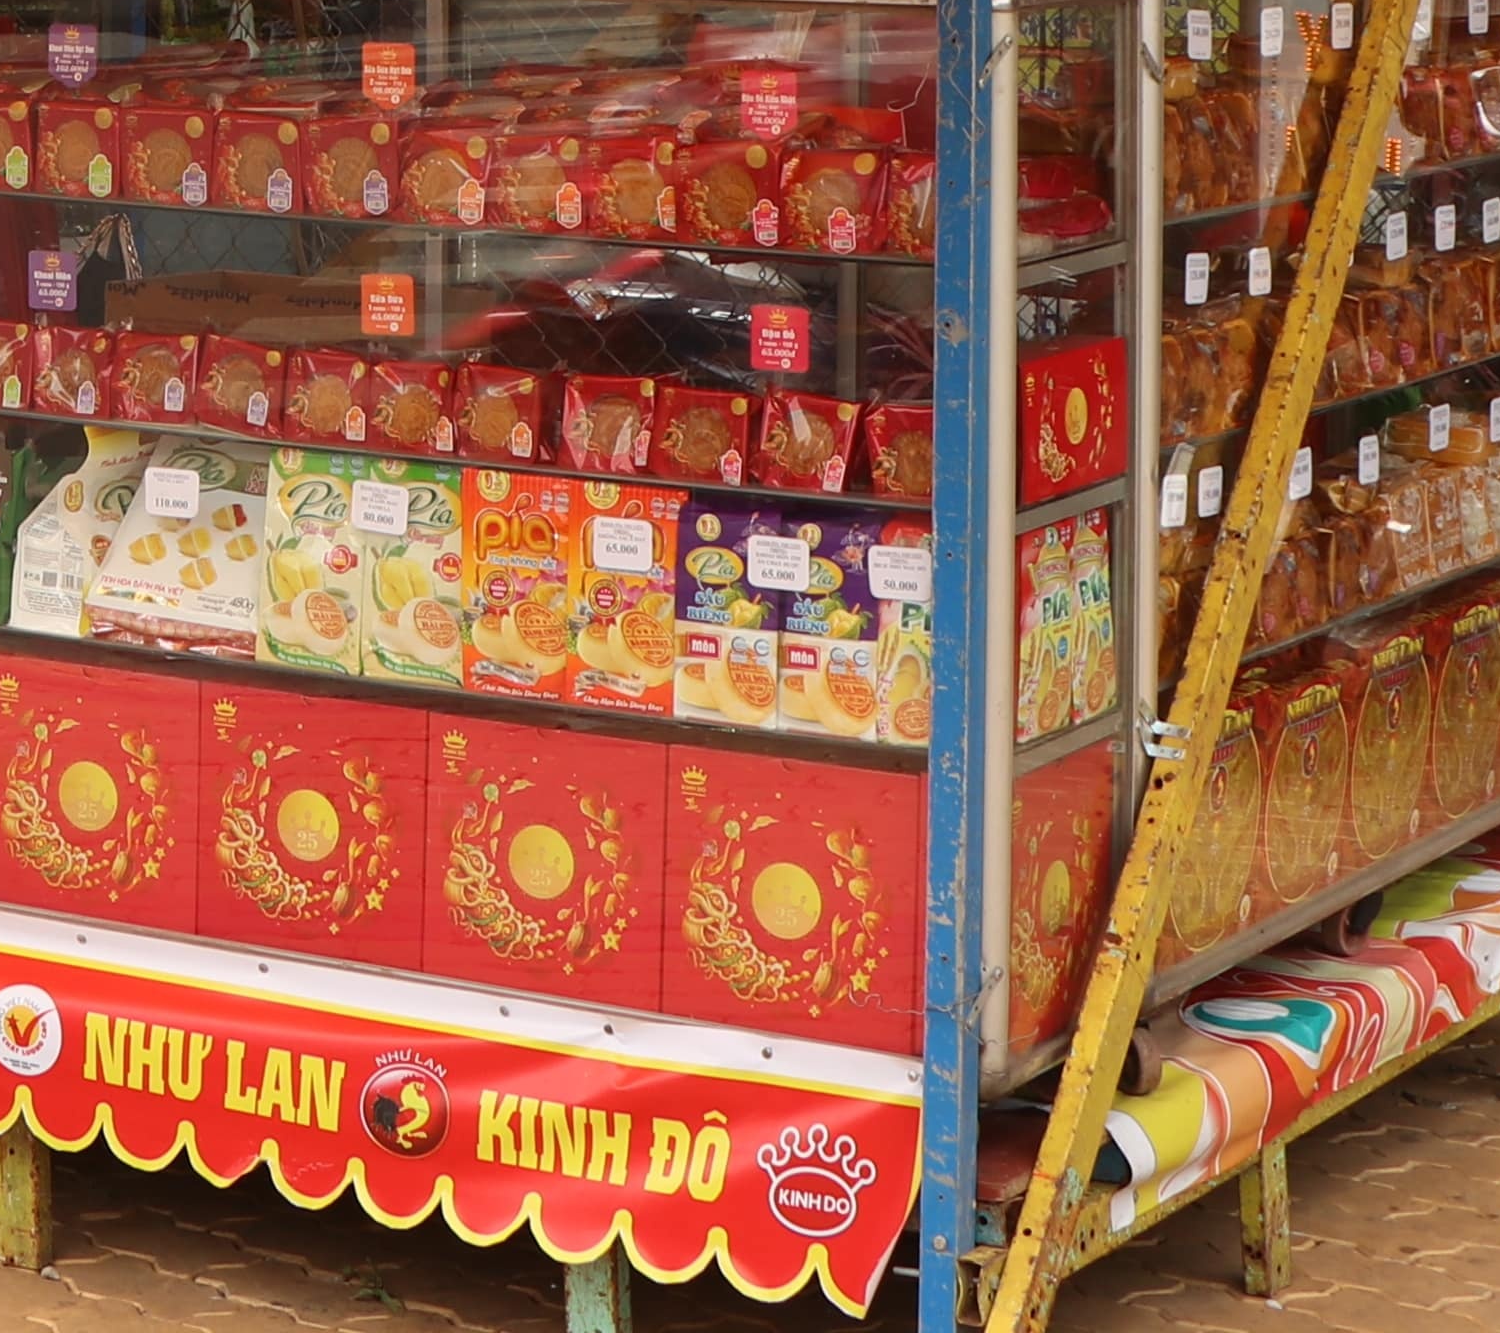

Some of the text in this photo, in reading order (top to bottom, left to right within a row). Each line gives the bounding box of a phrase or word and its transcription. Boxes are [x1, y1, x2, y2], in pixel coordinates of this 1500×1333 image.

[155, 497, 190, 510] 110.000
[288, 480, 349, 525] Pía
[362, 511, 396, 527] 80.000
[605, 540, 640, 556] 65.000
[761, 568, 797, 583] 65.000
[882, 578, 920, 593] 50.000
[1041, 589, 1072, 625] PÍA
[690, 636, 719, 657] Môn
[789, 648, 817, 670] Môn
[83, 1009, 348, 1133] NHƯ LAN
[476, 1088, 733, 1204] KINH ĐÔ
